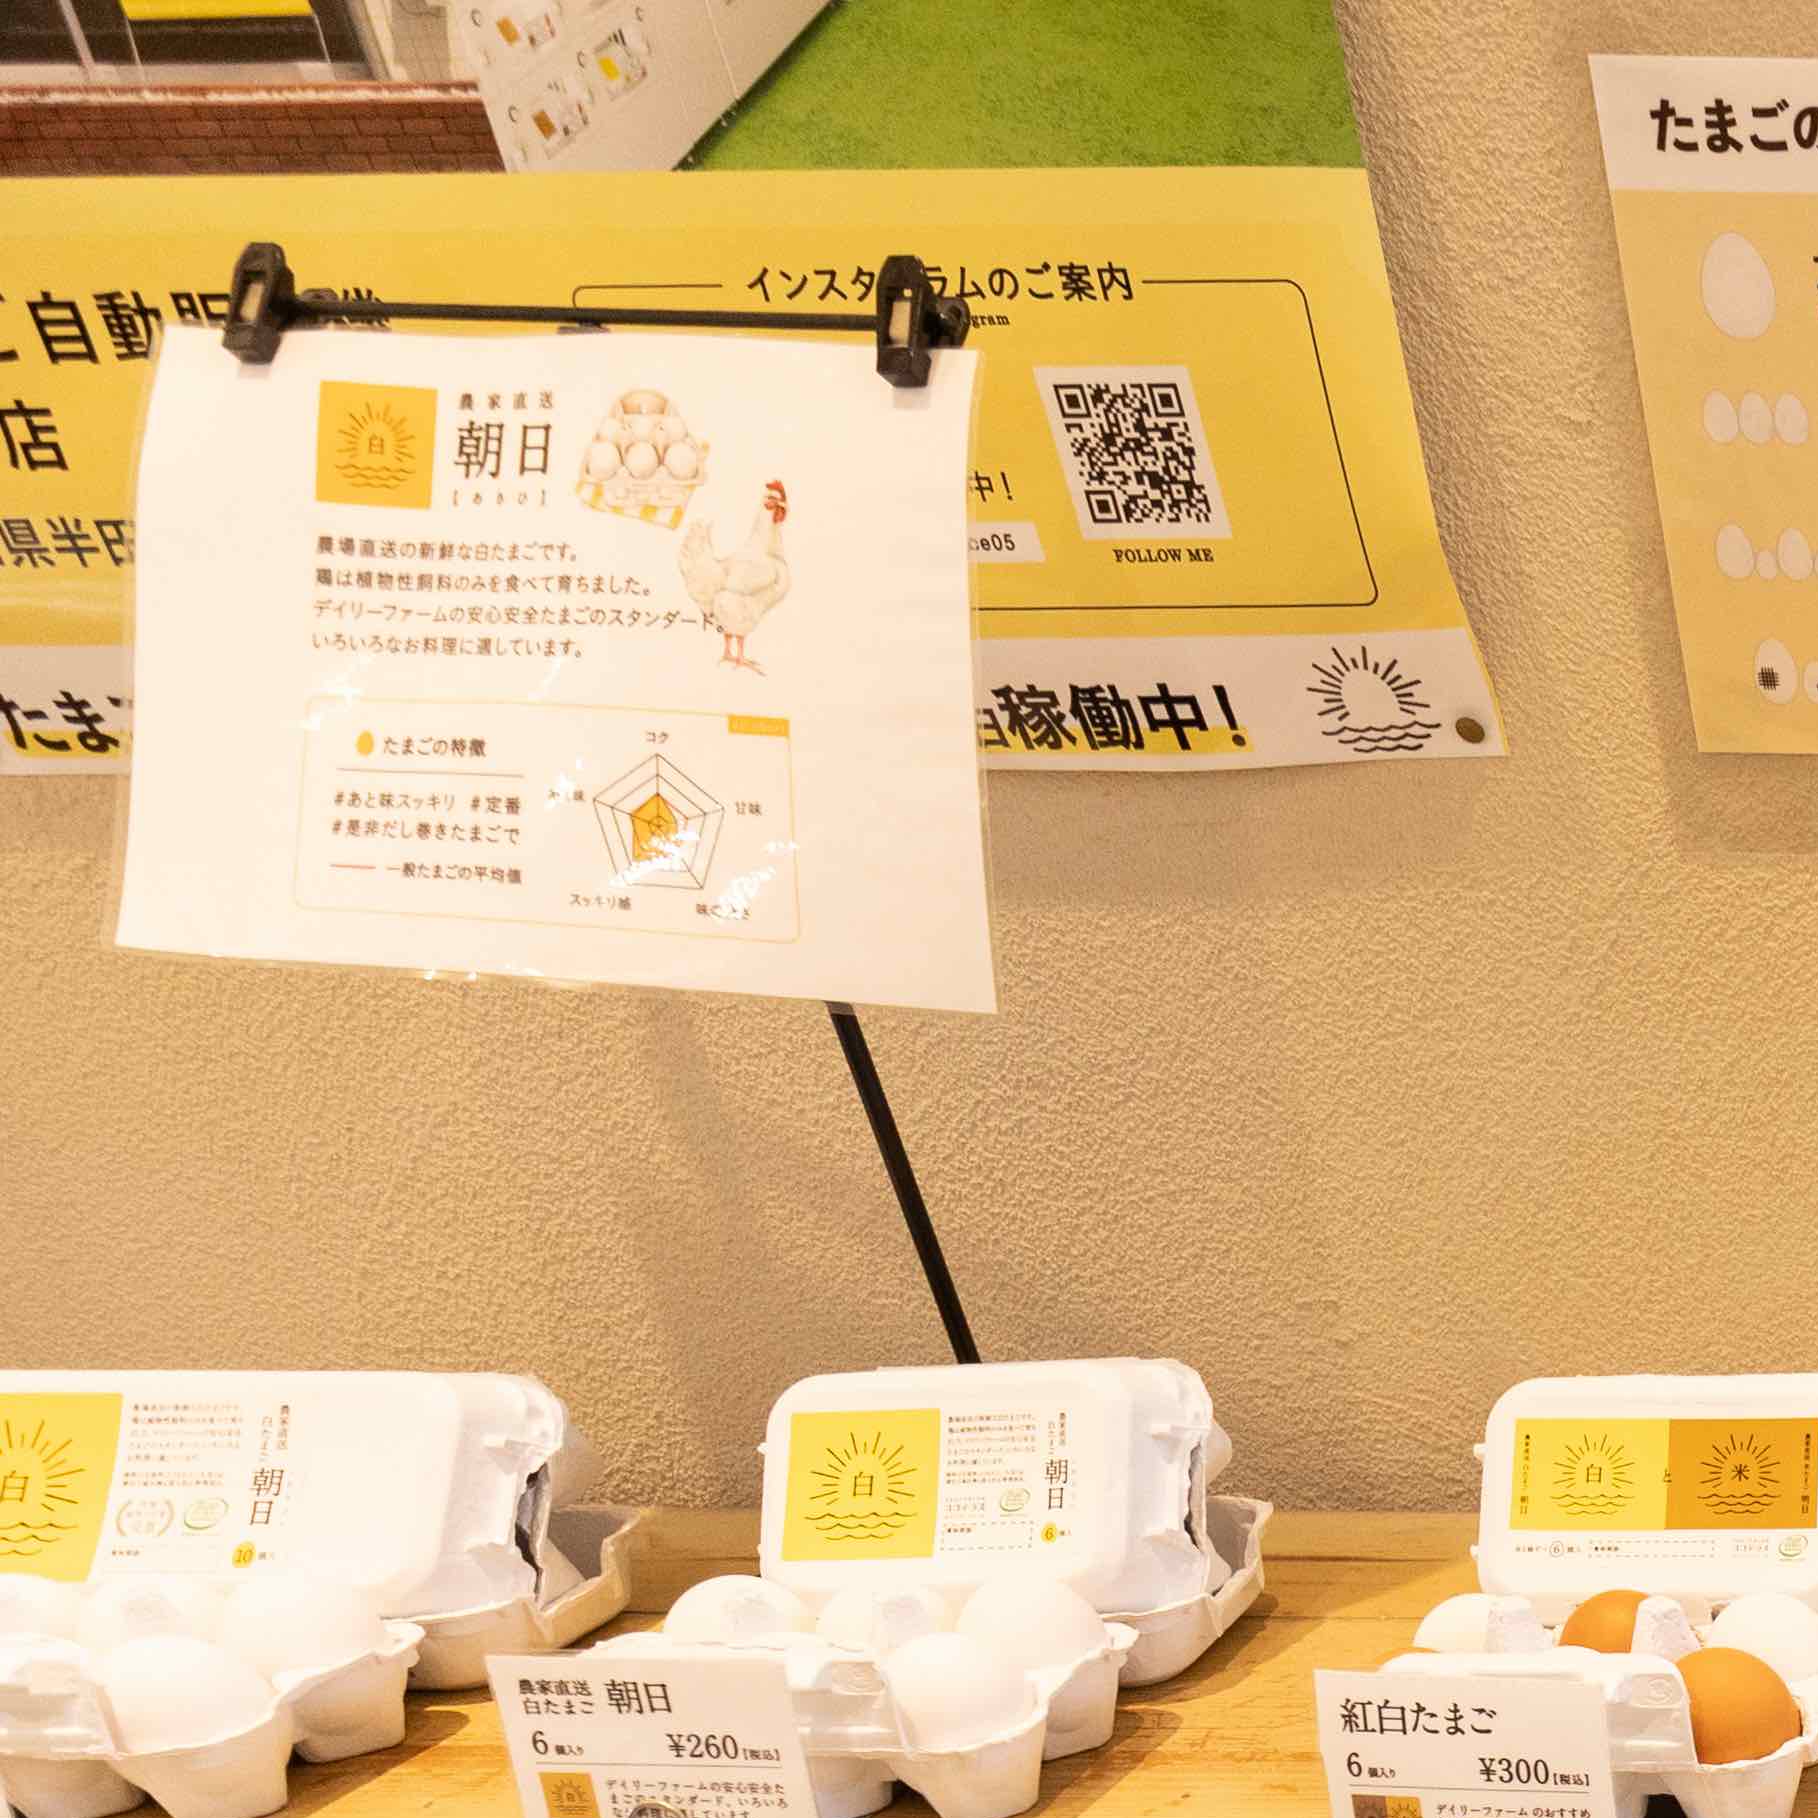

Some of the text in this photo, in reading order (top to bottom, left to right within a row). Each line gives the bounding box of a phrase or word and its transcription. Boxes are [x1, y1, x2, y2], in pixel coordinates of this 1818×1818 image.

[746, 262, 1135, 305] インスタラムのご案内
[457, 390, 555, 412] 農家直送
[452, 419, 553, 480] 朝日
[315, 533, 578, 564] 農場直送の新鮮な白たまごです。
[1113, 547, 1215, 564] FOLLOW ME
[314, 566, 652, 598] 鶏は植物性飼料のみを食べて育ちました。
[311, 599, 727, 636] デイリーファームの安心安全たまごのスタンダード。
[310, 630, 586, 661] いろいろなお料理に適しています。
[382, 735, 489, 760] たまごの特徴
[850, 1470, 875, 1498] 白
[1044, 1458, 1069, 1511] 朝日
[1585, 1463, 1603, 1484] 白
[1731, 1463, 1750, 1483] 米
[248, 1467, 285, 1527] 朝日
[518, 1678, 674, 1716] 農家直送 朝日
[1340, 1697, 1498, 1736] 紅白たまご
[531, 1730, 549, 1756] 6
[665, 1733, 739, 1760] ¥260
[1346, 1751, 1591, 1788] 6 ¥300 【税込】
